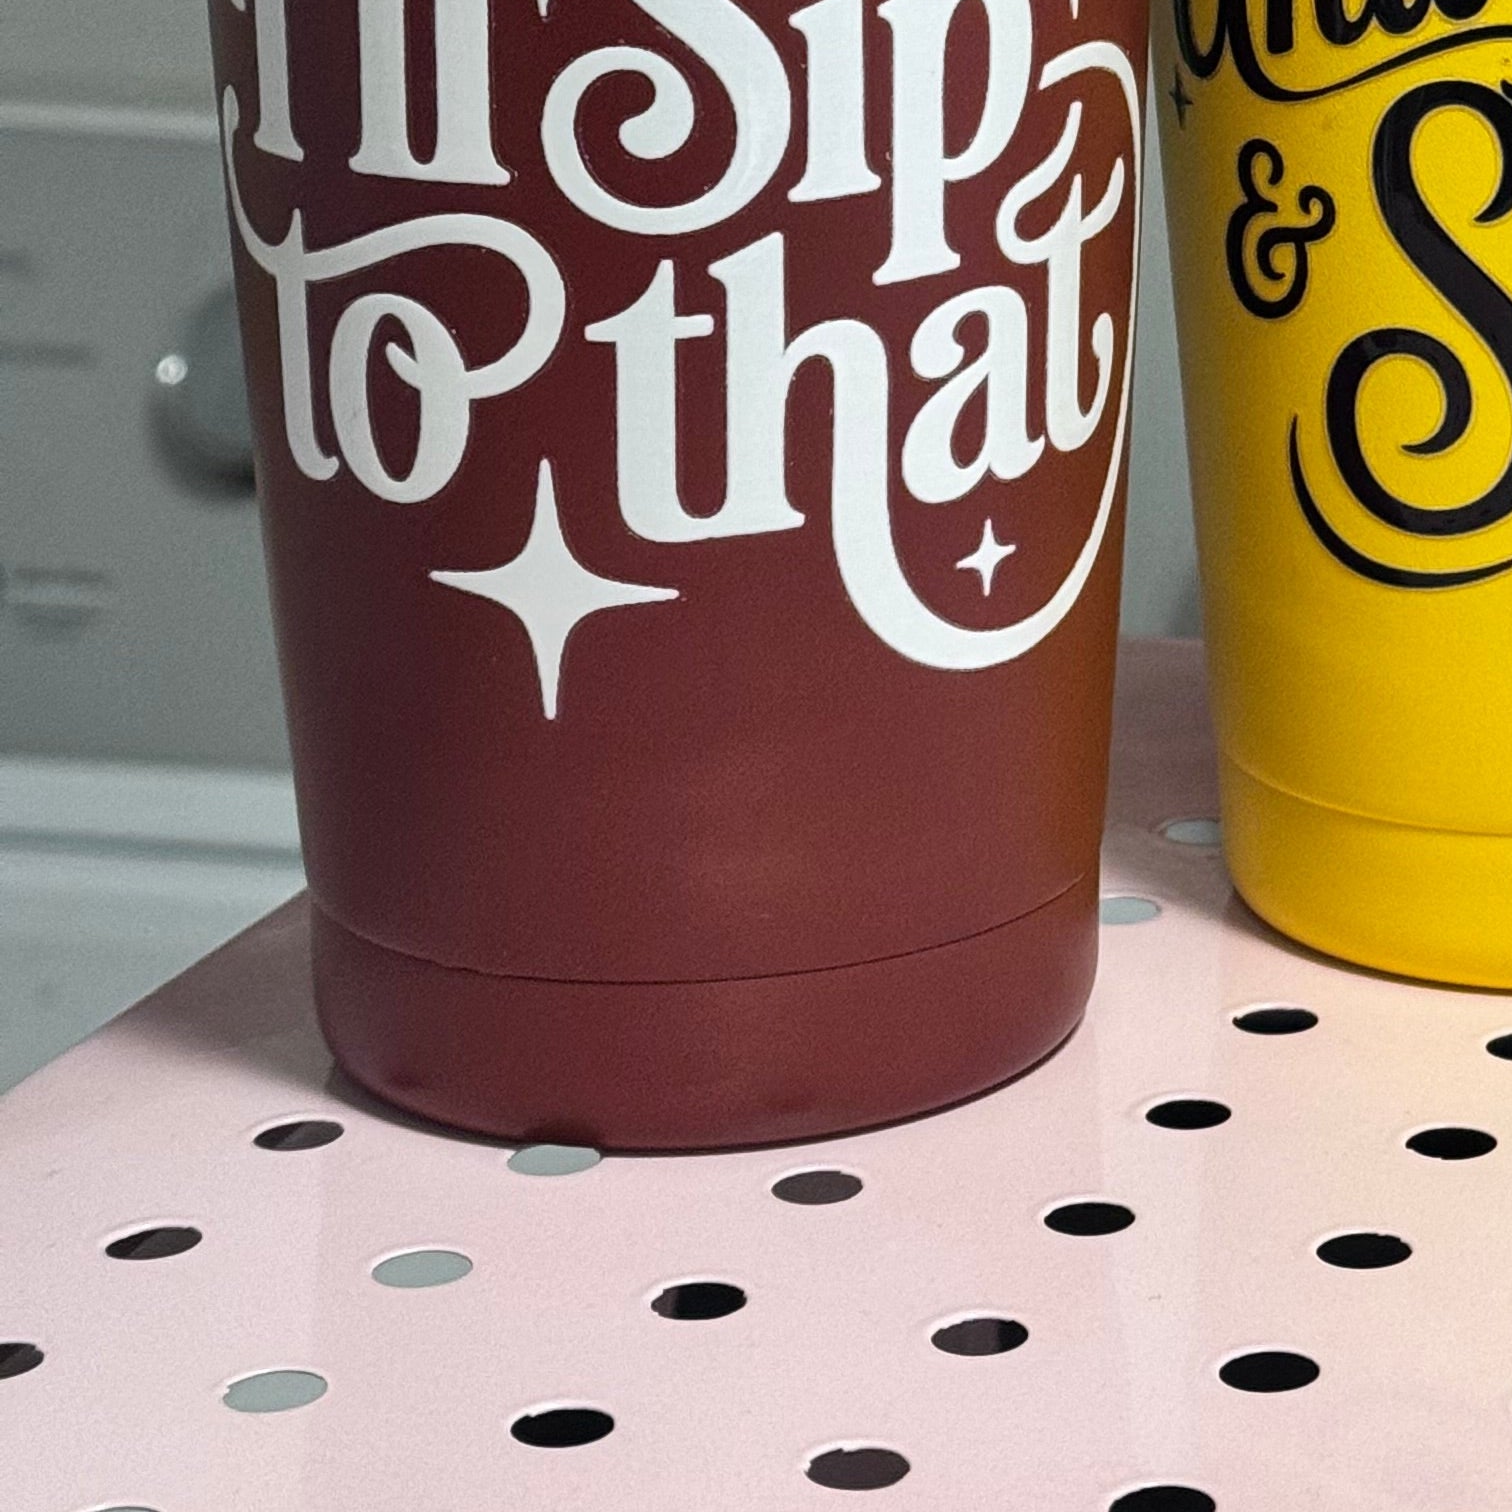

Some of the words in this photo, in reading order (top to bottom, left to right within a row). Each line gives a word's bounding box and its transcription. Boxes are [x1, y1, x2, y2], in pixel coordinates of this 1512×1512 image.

[223, 85, 567, 504] to
[584, 40, 1143, 672] that
[1225, 137, 1336, 320] &
